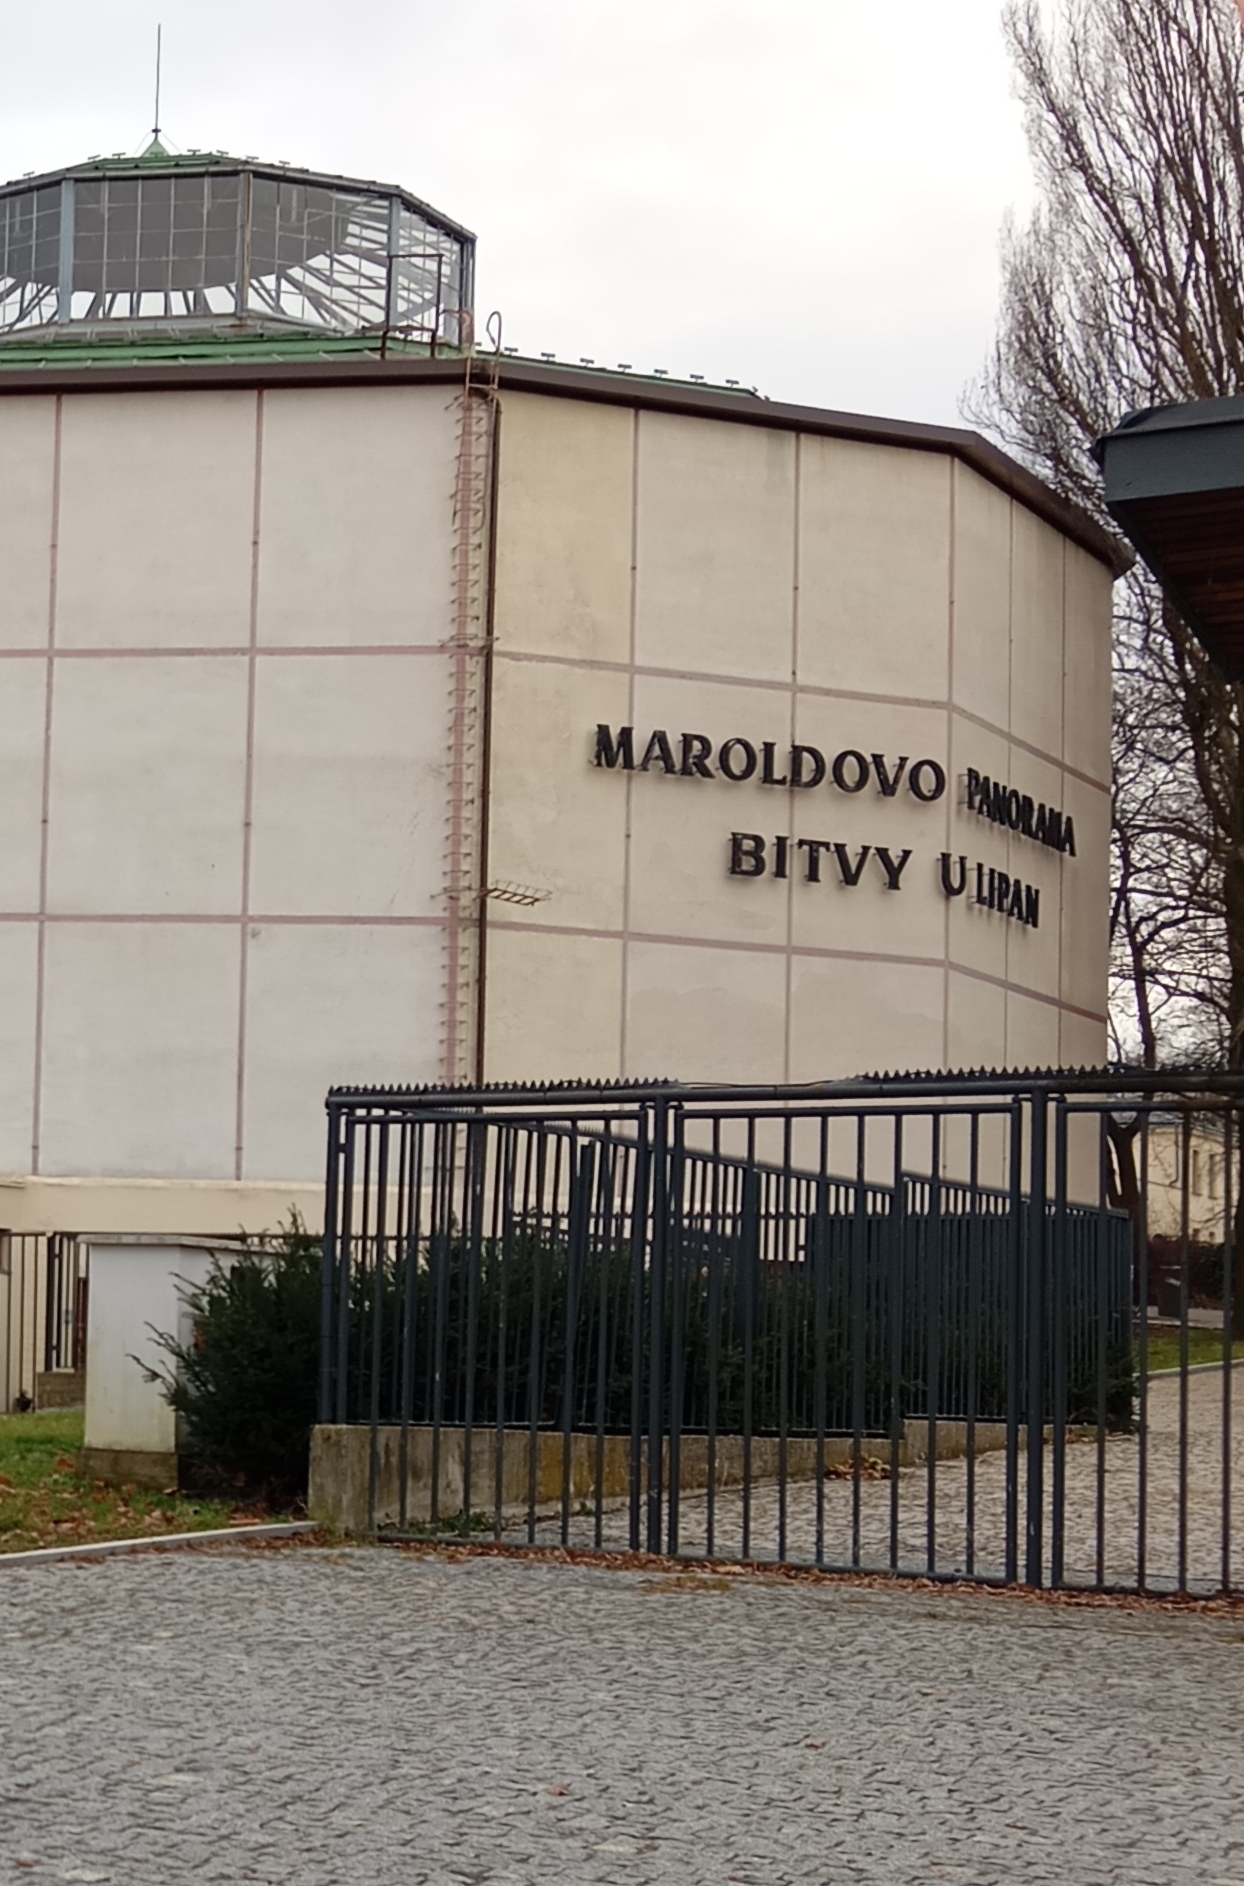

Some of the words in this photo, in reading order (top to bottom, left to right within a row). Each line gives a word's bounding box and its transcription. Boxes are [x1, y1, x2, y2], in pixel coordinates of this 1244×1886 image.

[595, 724, 946, 803] MAROLDOVO
[967, 767, 1076, 857] PANORAMA
[728, 832, 913, 891] BITVY
[940, 852, 967, 896] U
[975, 862, 1040, 929] LIPAN
